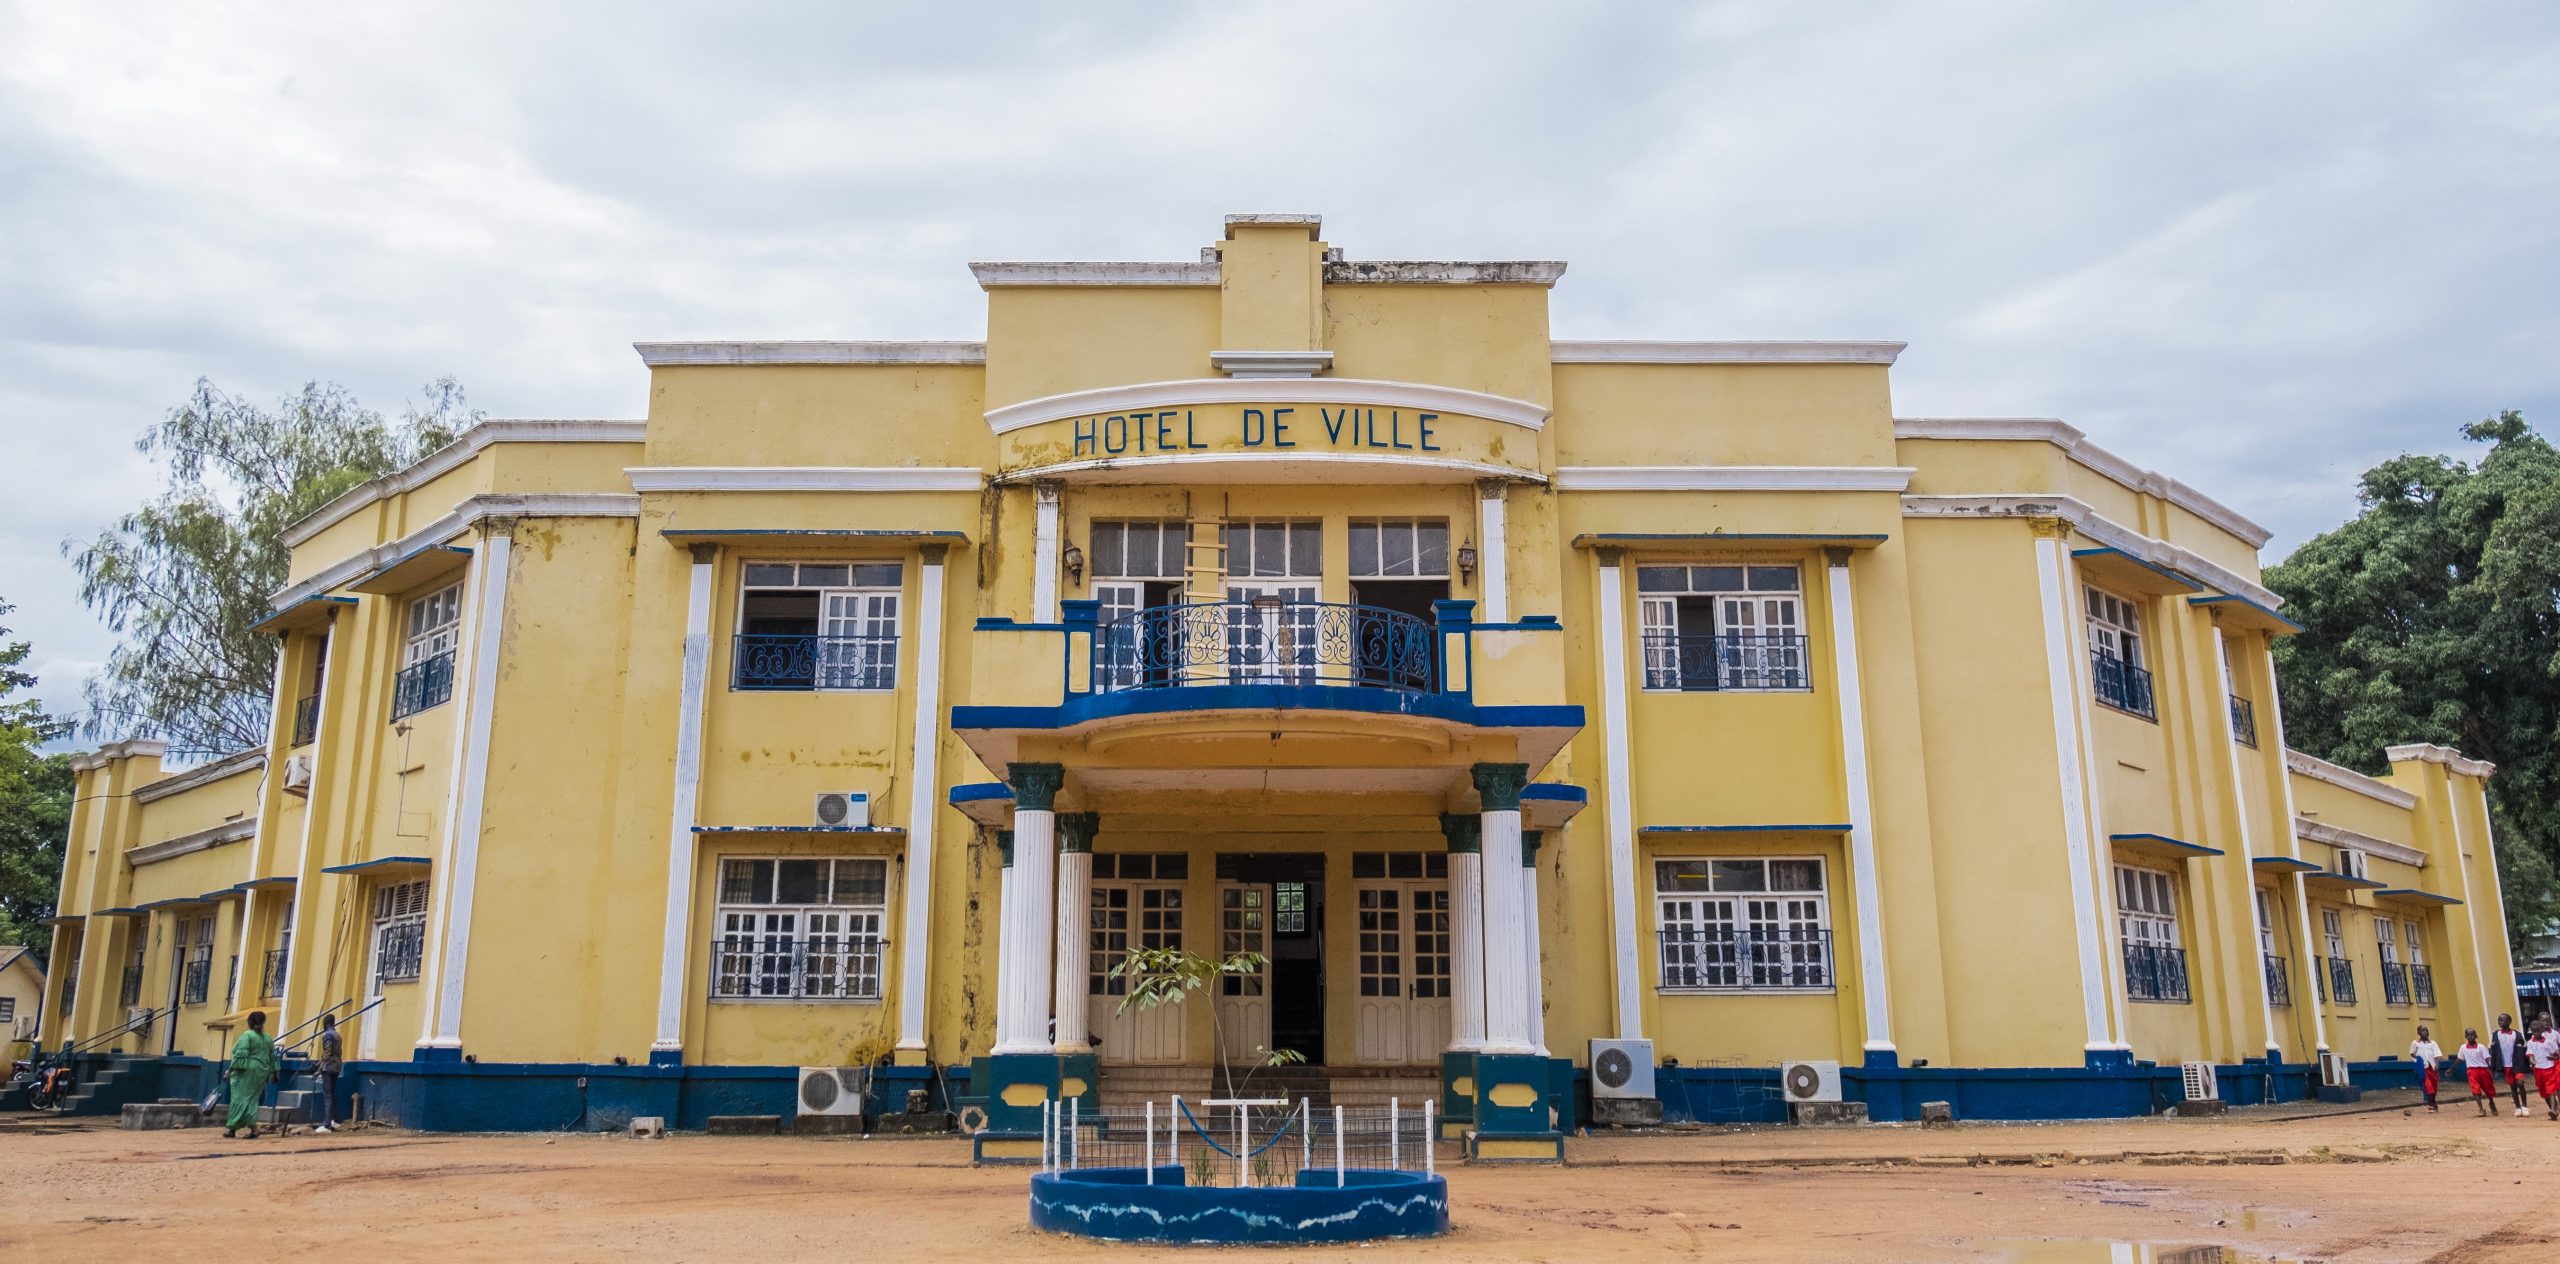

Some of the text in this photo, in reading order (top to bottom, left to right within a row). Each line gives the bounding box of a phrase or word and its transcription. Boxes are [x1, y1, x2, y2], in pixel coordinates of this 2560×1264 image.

[1074, 407, 1441, 457] HOTEL DE VILLE
